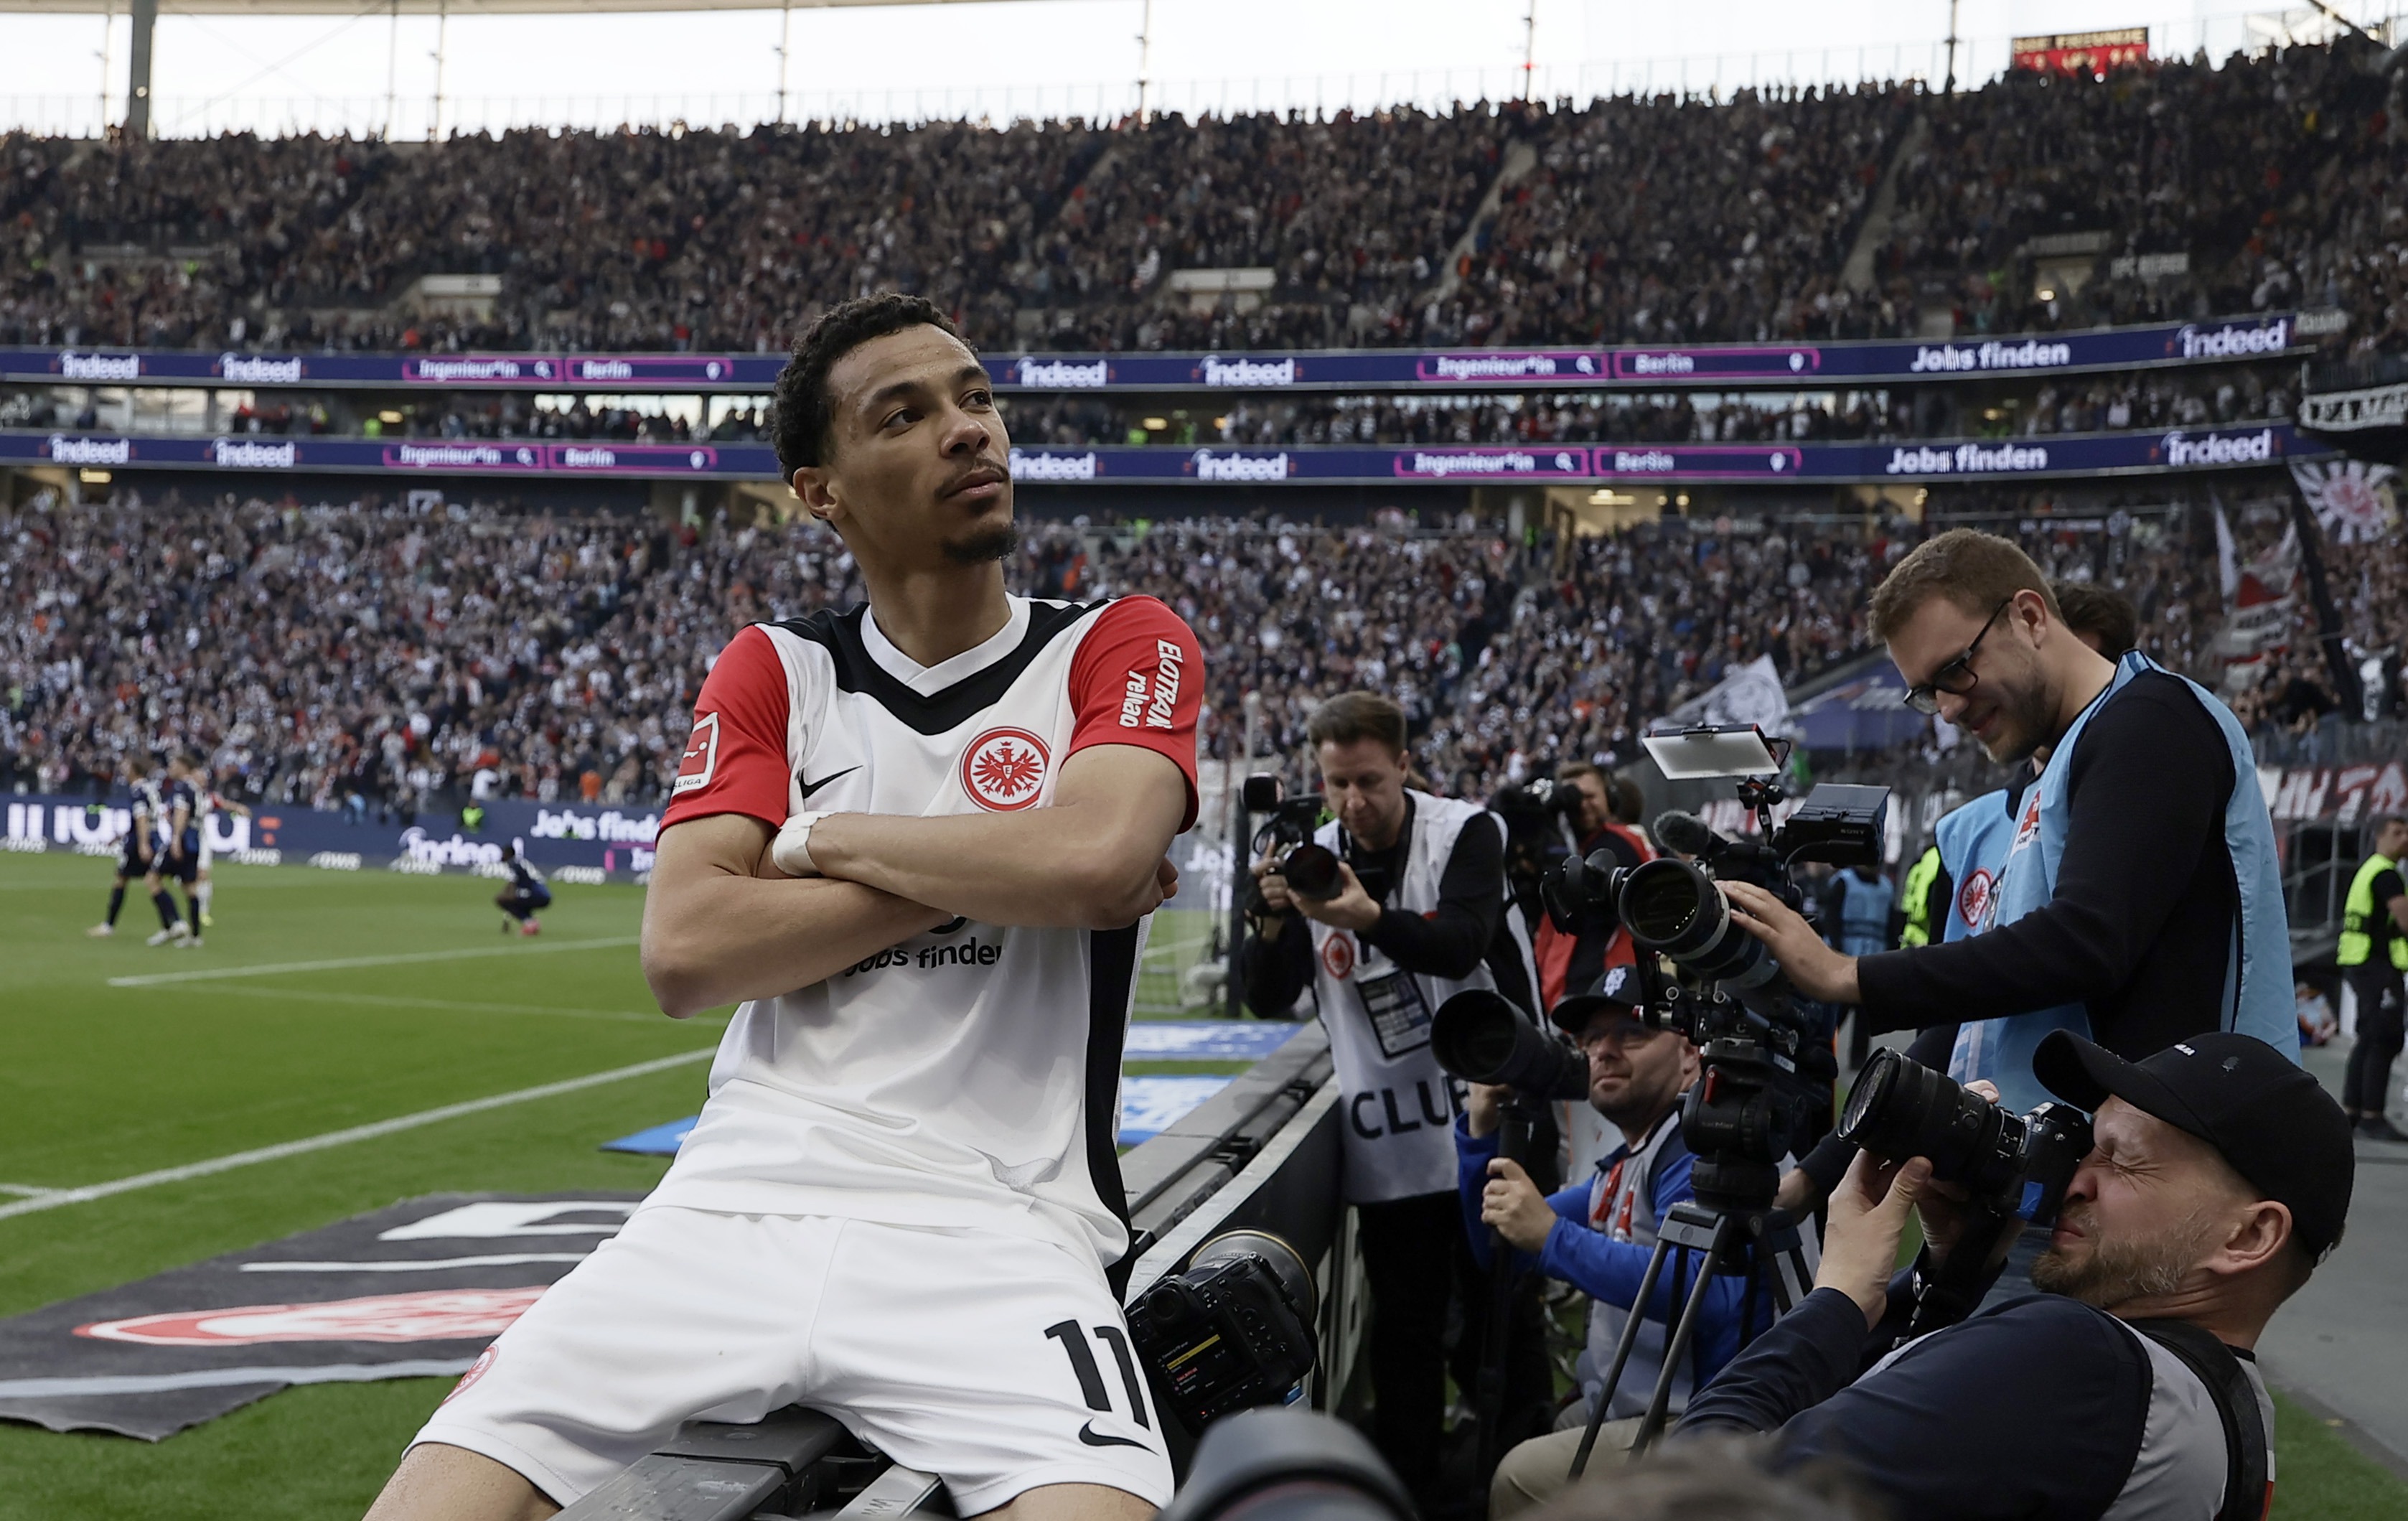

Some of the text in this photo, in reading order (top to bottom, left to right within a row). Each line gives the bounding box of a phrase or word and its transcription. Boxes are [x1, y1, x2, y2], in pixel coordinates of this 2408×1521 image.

[2179, 319, 2287, 359] indeed
[62, 350, 139, 380] indeed
[222, 352, 301, 383] indeed
[582, 360, 632, 380] Berlin
[1019, 357, 1107, 388] indeed
[1202, 355, 1295, 387] indeed
[1634, 352, 1694, 374] Berlin
[1911, 340, 2071, 373] Jobs finden
[50, 433, 130, 464] indeed
[214, 436, 296, 468] indeed
[564, 447, 616, 467] Berlin
[1614, 450, 1674, 472] Berlin
[1886, 442, 2048, 474] Jobs finden
[2165, 429, 2272, 467] indeed
[1008, 449, 1096, 481] indeed
[1194, 449, 1289, 481] indeed
[1044, 1319, 1151, 1433] 11
